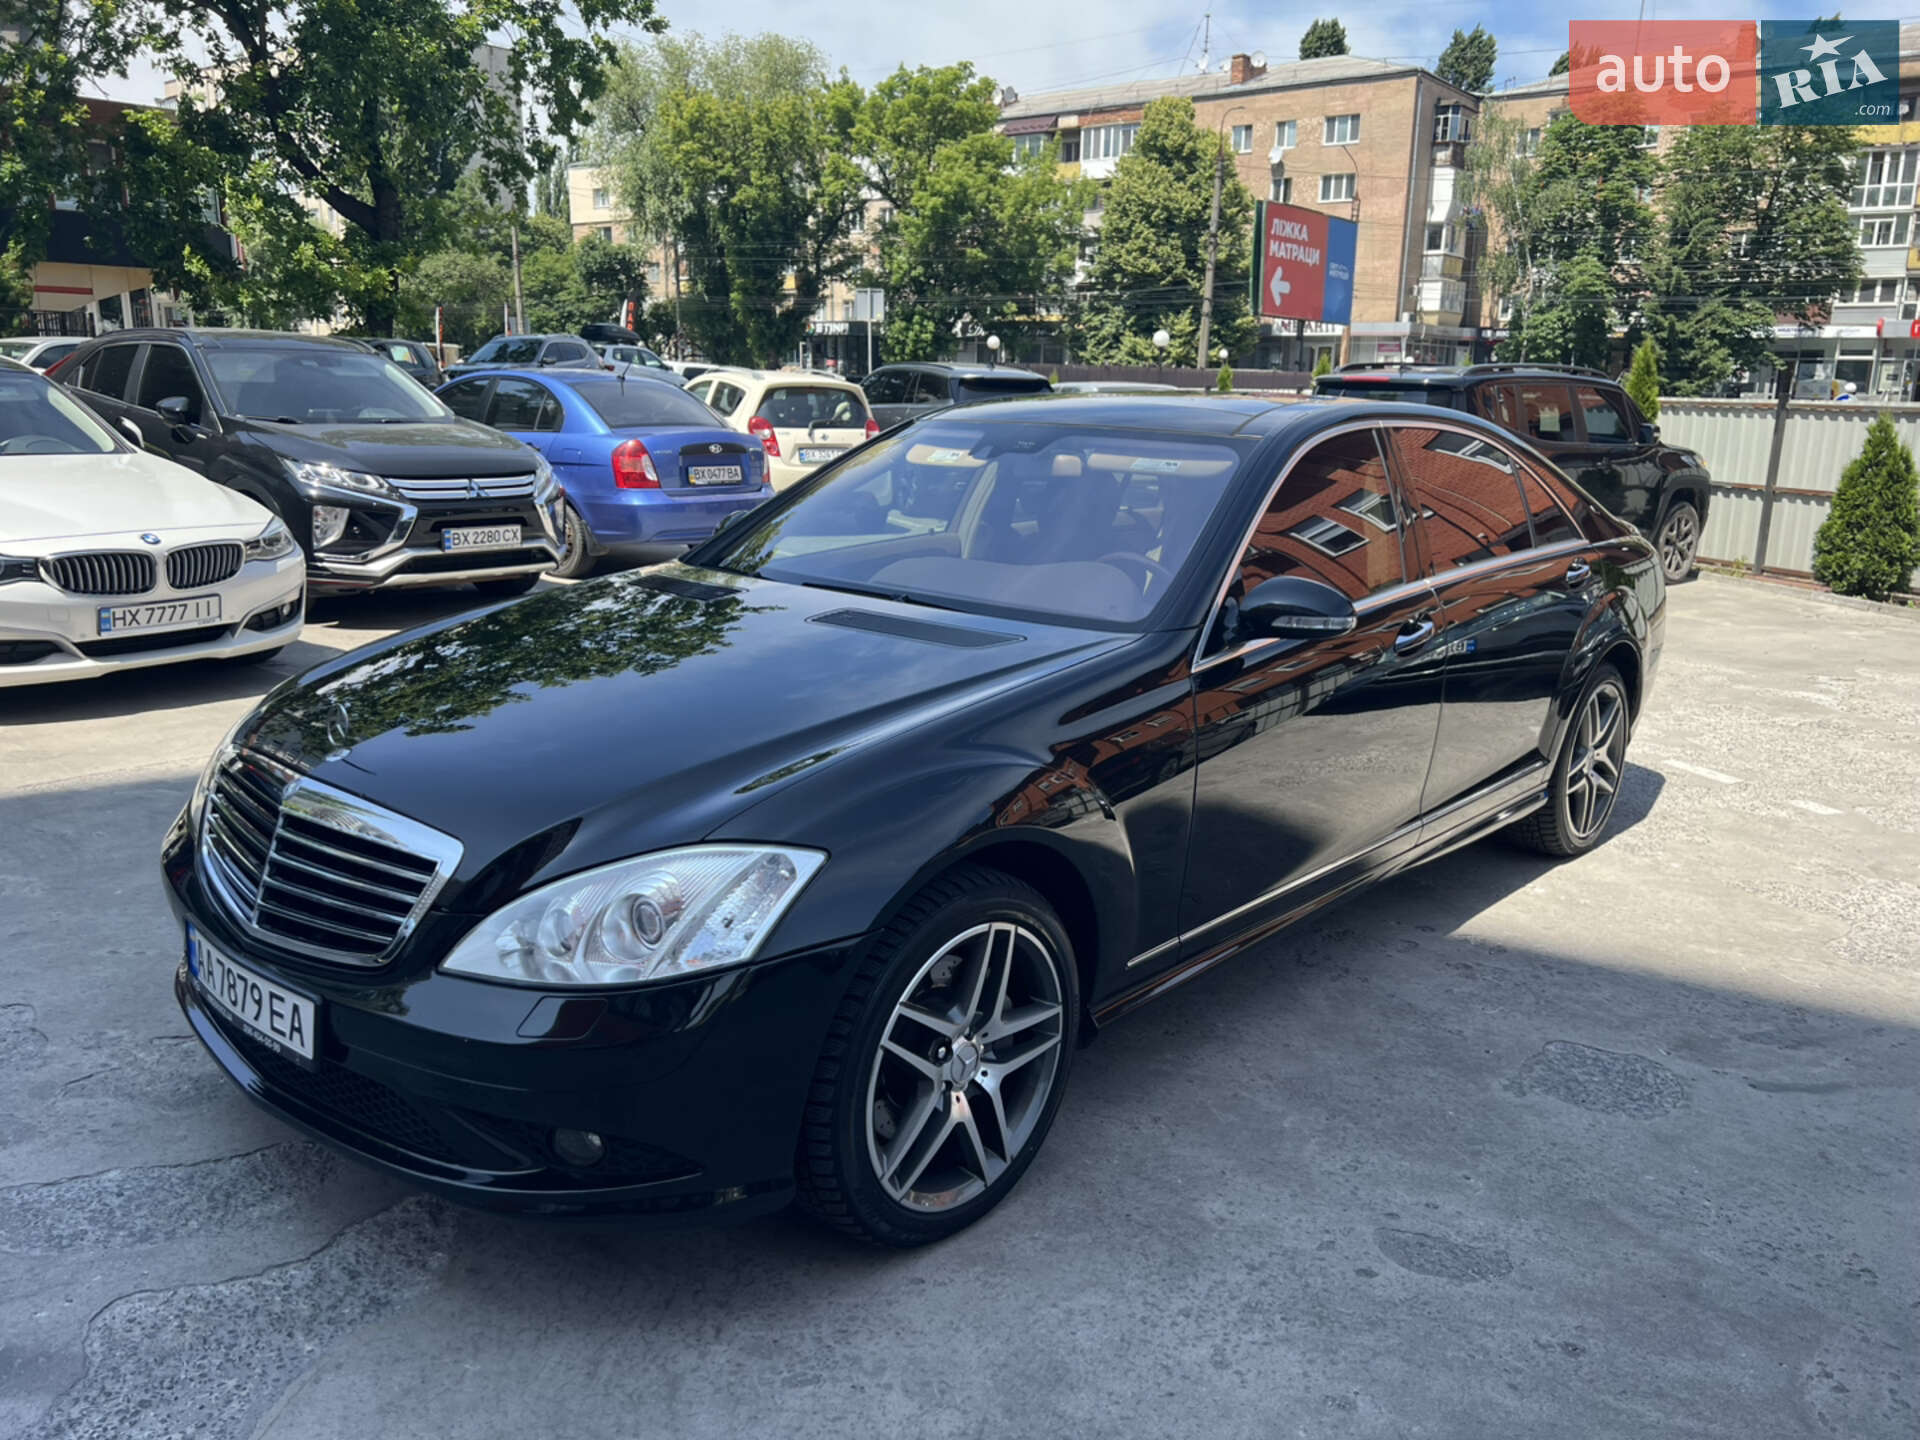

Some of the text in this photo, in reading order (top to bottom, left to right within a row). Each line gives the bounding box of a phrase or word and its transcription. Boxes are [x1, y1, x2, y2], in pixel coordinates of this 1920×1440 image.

[1271, 218, 1309, 242] ЛІЖКА
[1269, 239, 1321, 267] МАТРАЦИ
[452, 528, 520, 546] BX 2280 CX
[112, 608, 141, 628] HX
[144, 603, 188, 624] 7777
[216, 956, 263, 1022] 7879
[268, 990, 306, 1049] EA
